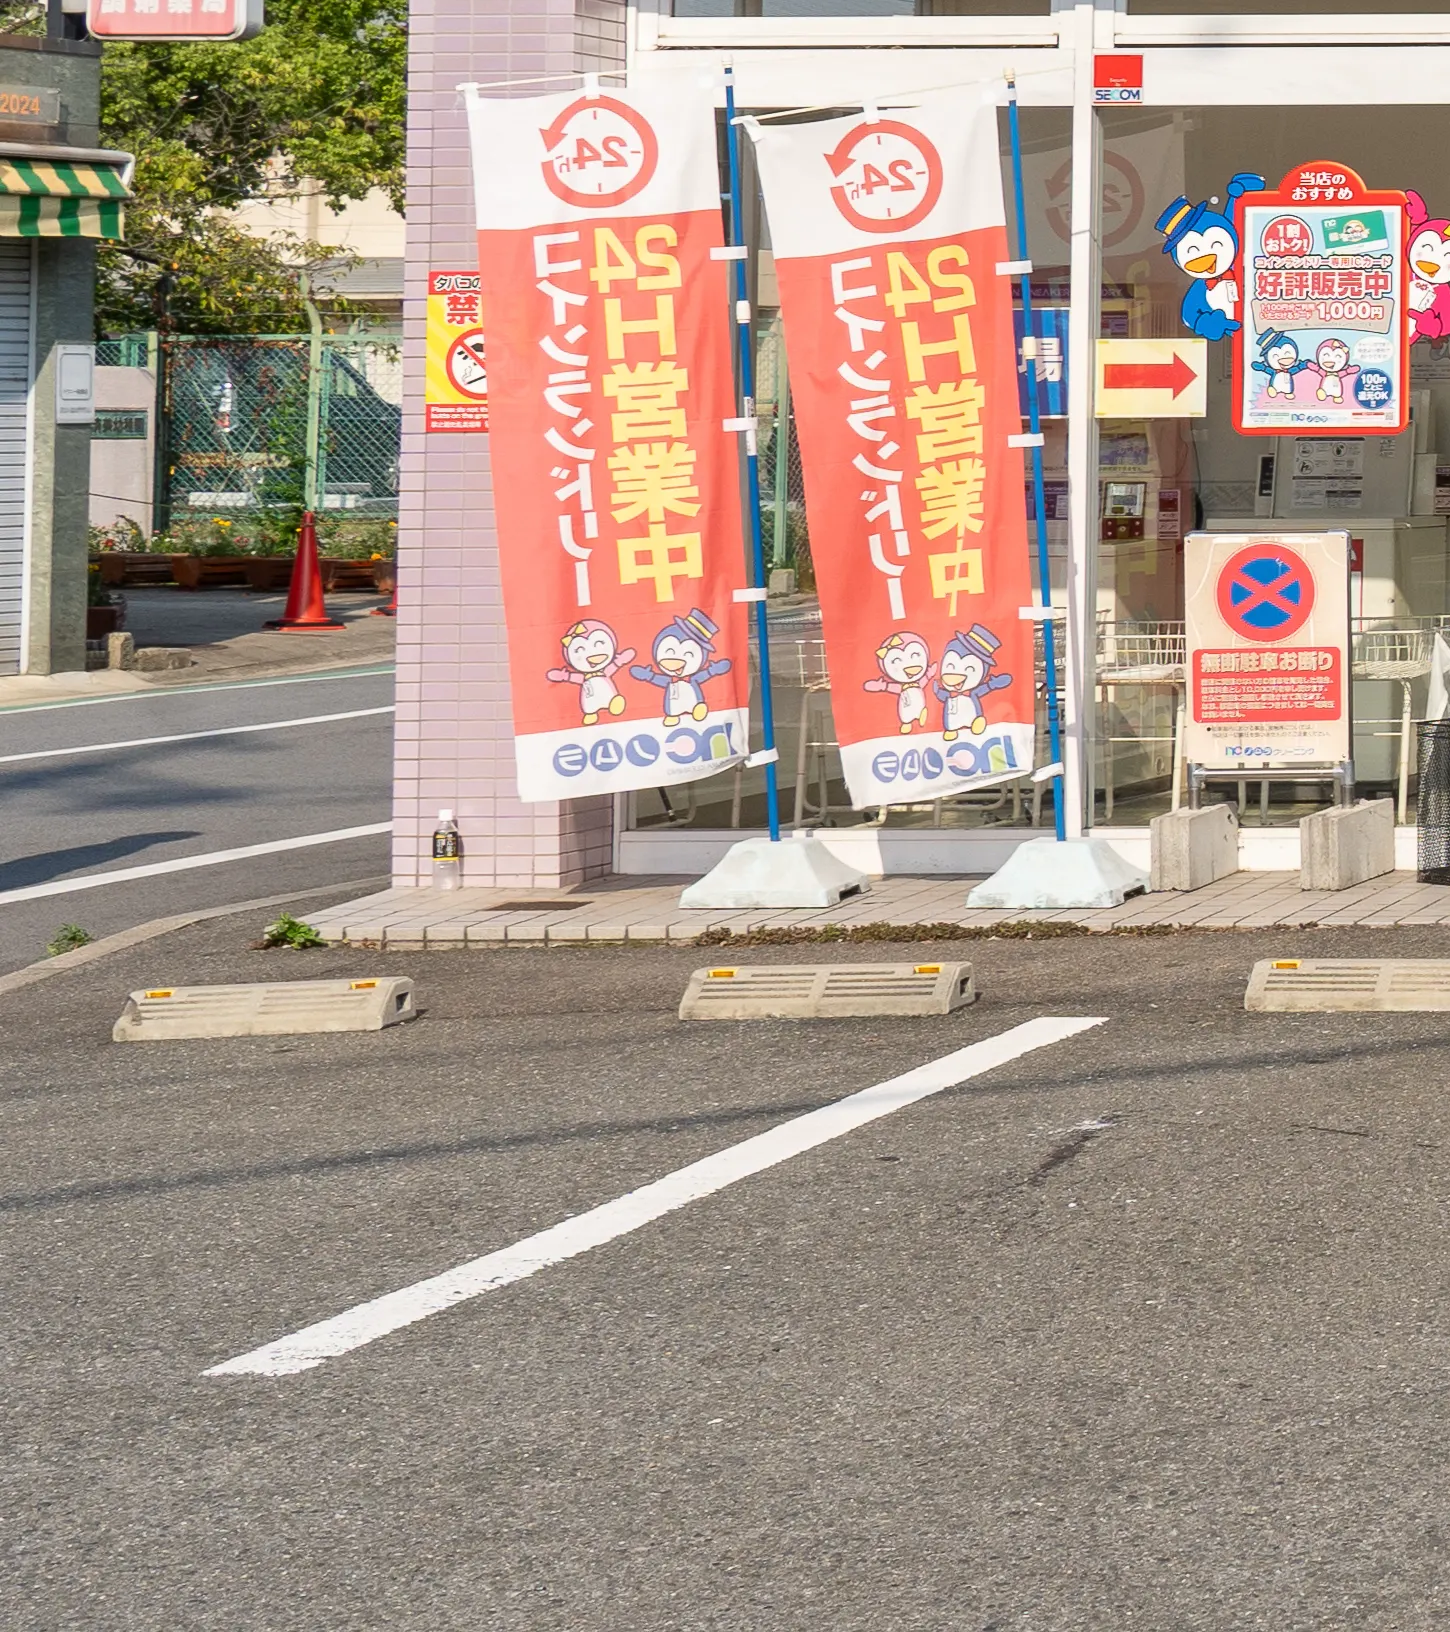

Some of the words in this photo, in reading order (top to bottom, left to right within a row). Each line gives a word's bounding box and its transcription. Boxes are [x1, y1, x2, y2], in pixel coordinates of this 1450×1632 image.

[1095, 89, 1140, 100] SECOM
[1300, 172, 1346, 186] 当店の
[1291, 187, 1353, 200] おすすめ
[1276, 223, 1301, 237] 1割
[1254, 255, 1392, 269] コインランドリー専用ICカード
[1256, 270, 1392, 299] 好評販売中
[1316, 302, 1384, 321] 1,000円
[1201, 651, 1334, 673] 無断駐車お断り
